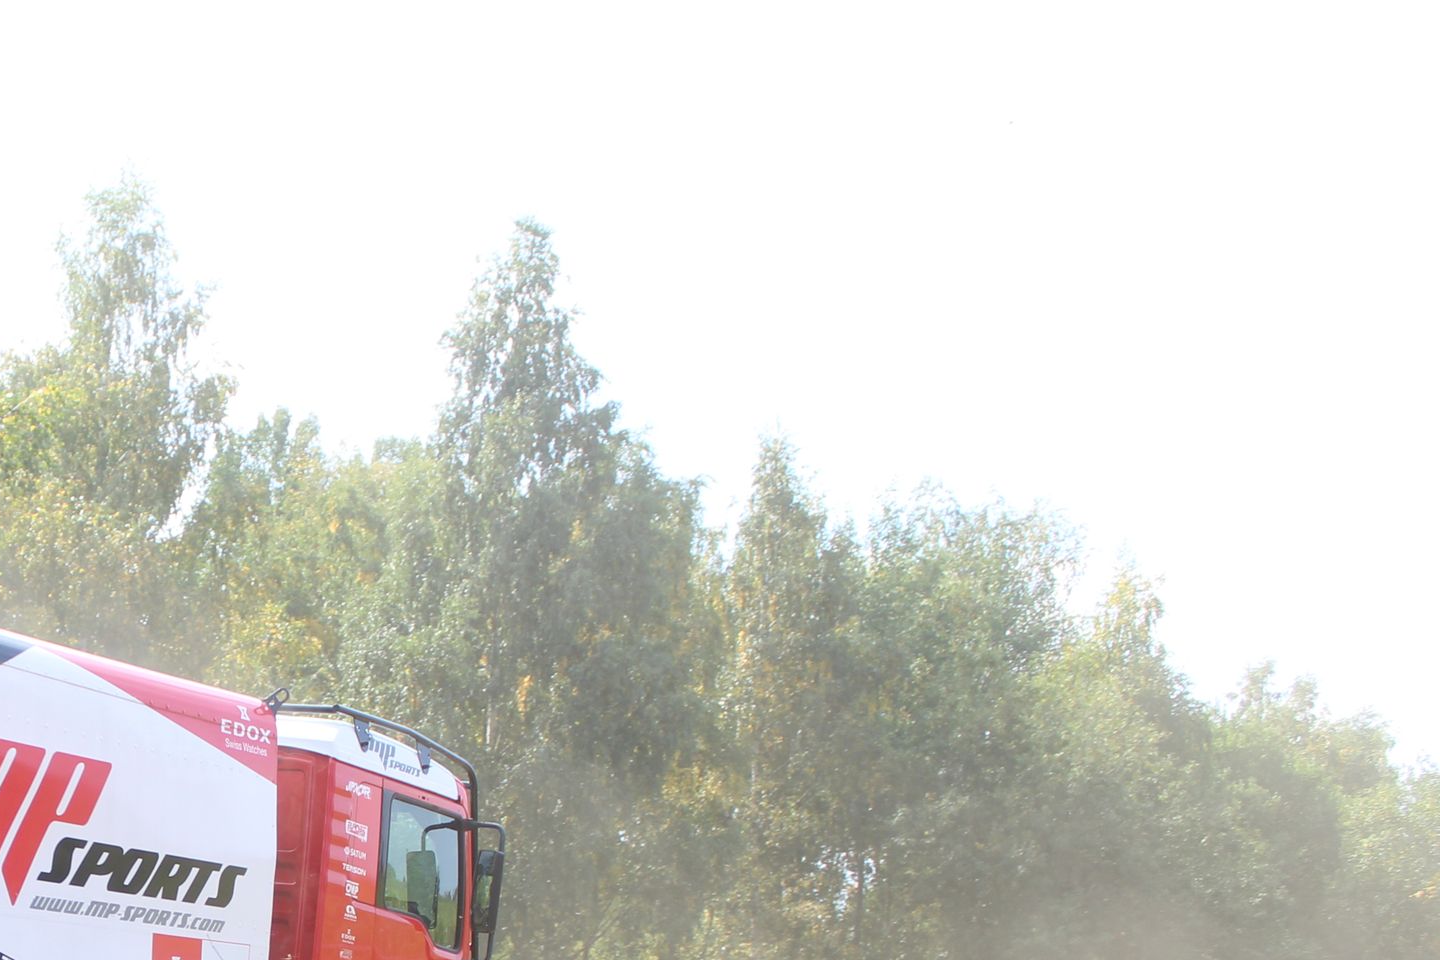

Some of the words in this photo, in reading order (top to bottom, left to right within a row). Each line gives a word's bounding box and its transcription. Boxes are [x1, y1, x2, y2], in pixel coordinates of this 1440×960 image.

[220, 718, 272, 746] EDOX
[389, 760, 421, 777] SPORTS
[37, 837, 248, 909] SPORTS
